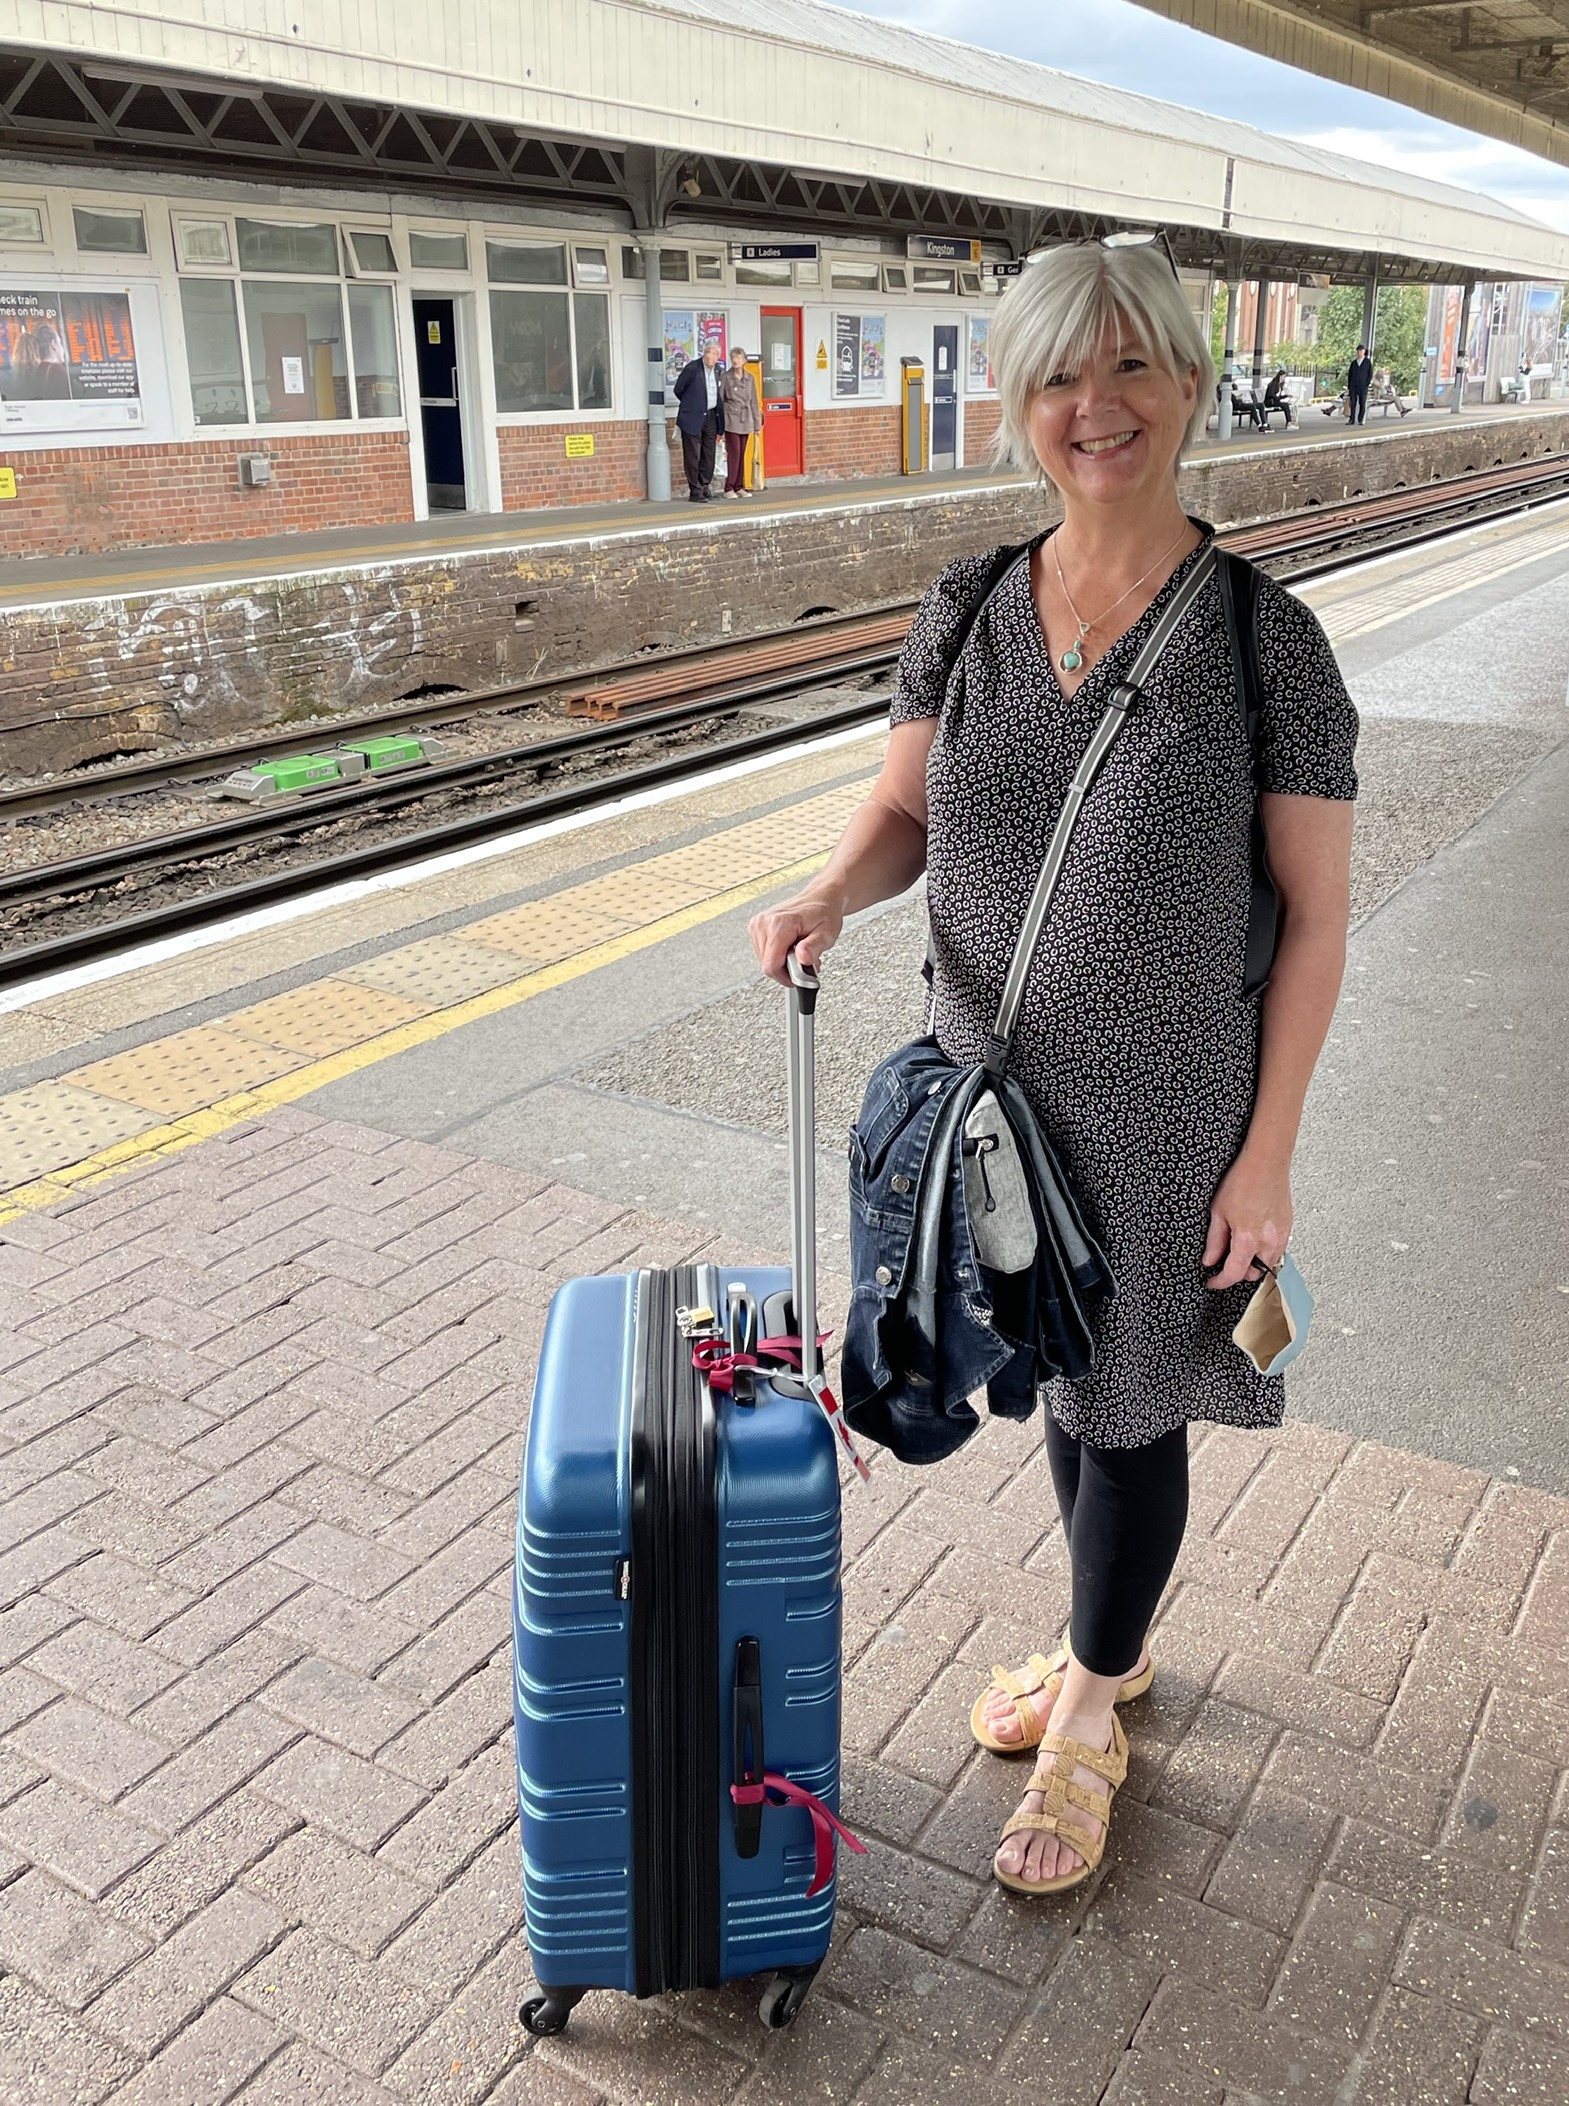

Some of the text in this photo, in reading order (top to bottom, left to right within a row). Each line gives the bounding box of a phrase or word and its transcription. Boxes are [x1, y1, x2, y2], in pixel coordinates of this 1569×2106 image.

[758, 247, 781, 257] Ladies
[926, 241, 955, 258] Kingston
[0, 294, 38, 305] eck train
[17, 308, 29, 316] on
[30, 306, 45, 317] the
[46, 308, 57, 319] go
